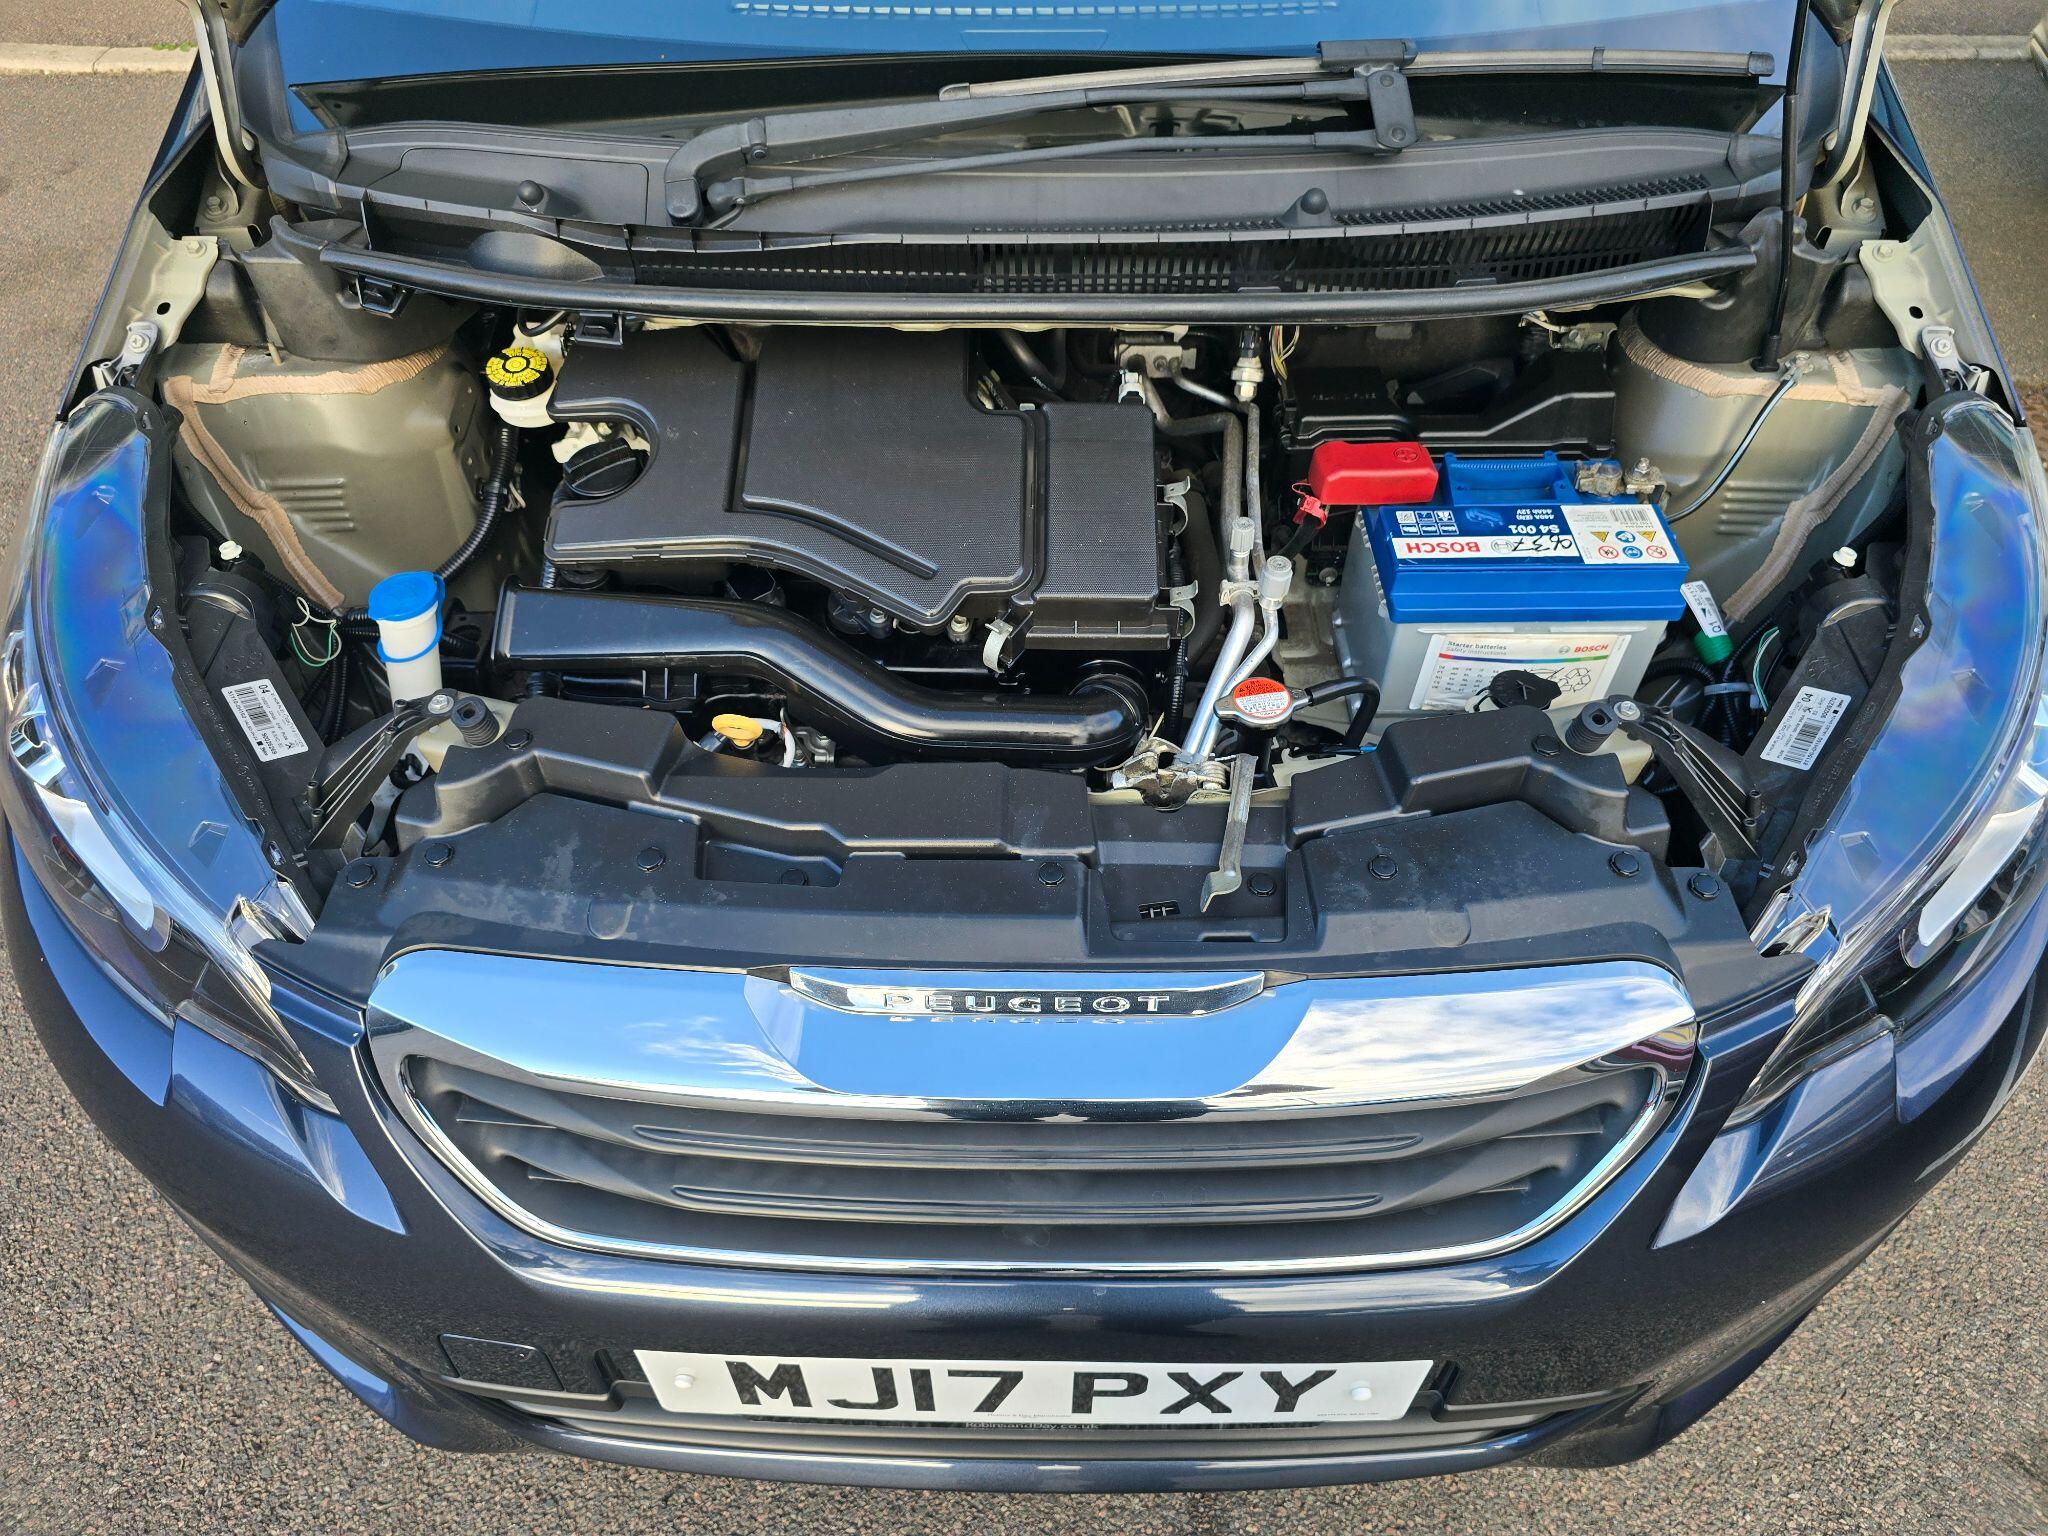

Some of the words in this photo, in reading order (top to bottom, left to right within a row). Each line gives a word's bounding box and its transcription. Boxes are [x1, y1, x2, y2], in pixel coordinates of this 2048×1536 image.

[1508, 525, 1537, 534] 001
[1539, 525, 1560, 534] S4
[1405, 542, 1480, 553] BOSCH
[1447, 641, 1473, 649] Starter
[1574, 644, 1609, 653] BOSCH
[258, 684, 271, 694] 04
[1801, 692, 1813, 702] 04
[884, 993, 1170, 1013] PEUGEOT
[725, 1361, 1023, 1413] MJ17
[1072, 1369, 1338, 1415] PXY
